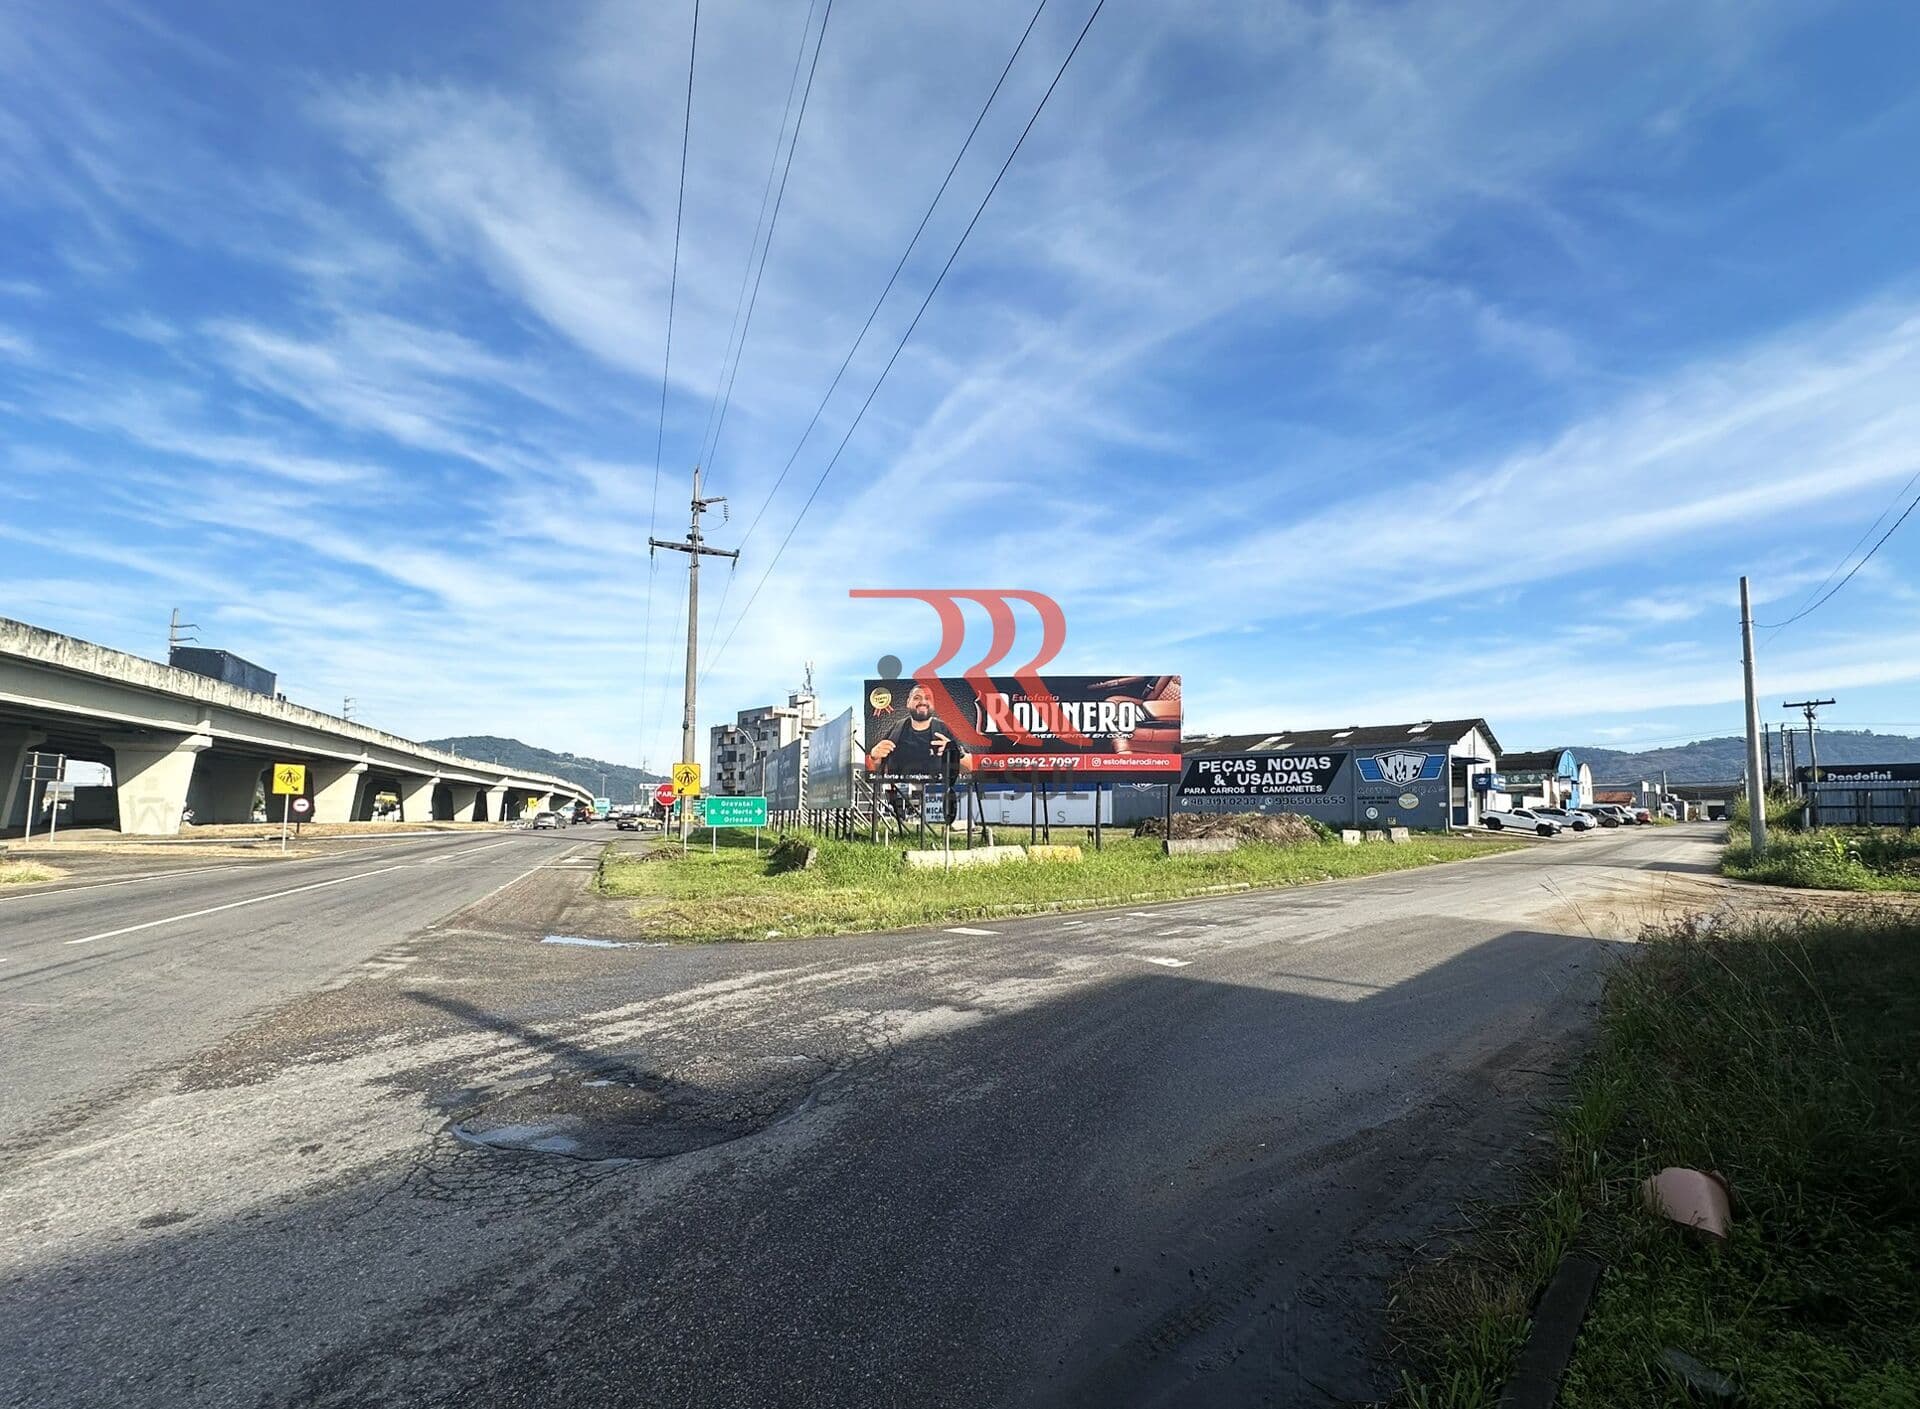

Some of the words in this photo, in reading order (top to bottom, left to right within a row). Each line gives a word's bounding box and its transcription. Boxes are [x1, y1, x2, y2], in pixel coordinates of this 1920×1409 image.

[1012, 693, 1060, 702] Estofaria
[1102, 758, 1170, 767] estofariarodinero
[1198, 759, 1257, 776] PEÇAS
[1267, 756, 1331, 771] NOVAS
[1214, 773, 1226, 786] &
[1237, 771, 1314, 786] USADAS
[1827, 770, 1892, 781] Dandolini
[1184, 787, 1206, 795] PARA
[1210, 786, 1246, 794] CARROS
[1250, 786, 1257, 794] E
[1262, 784, 1323, 794] CAMIONETES
